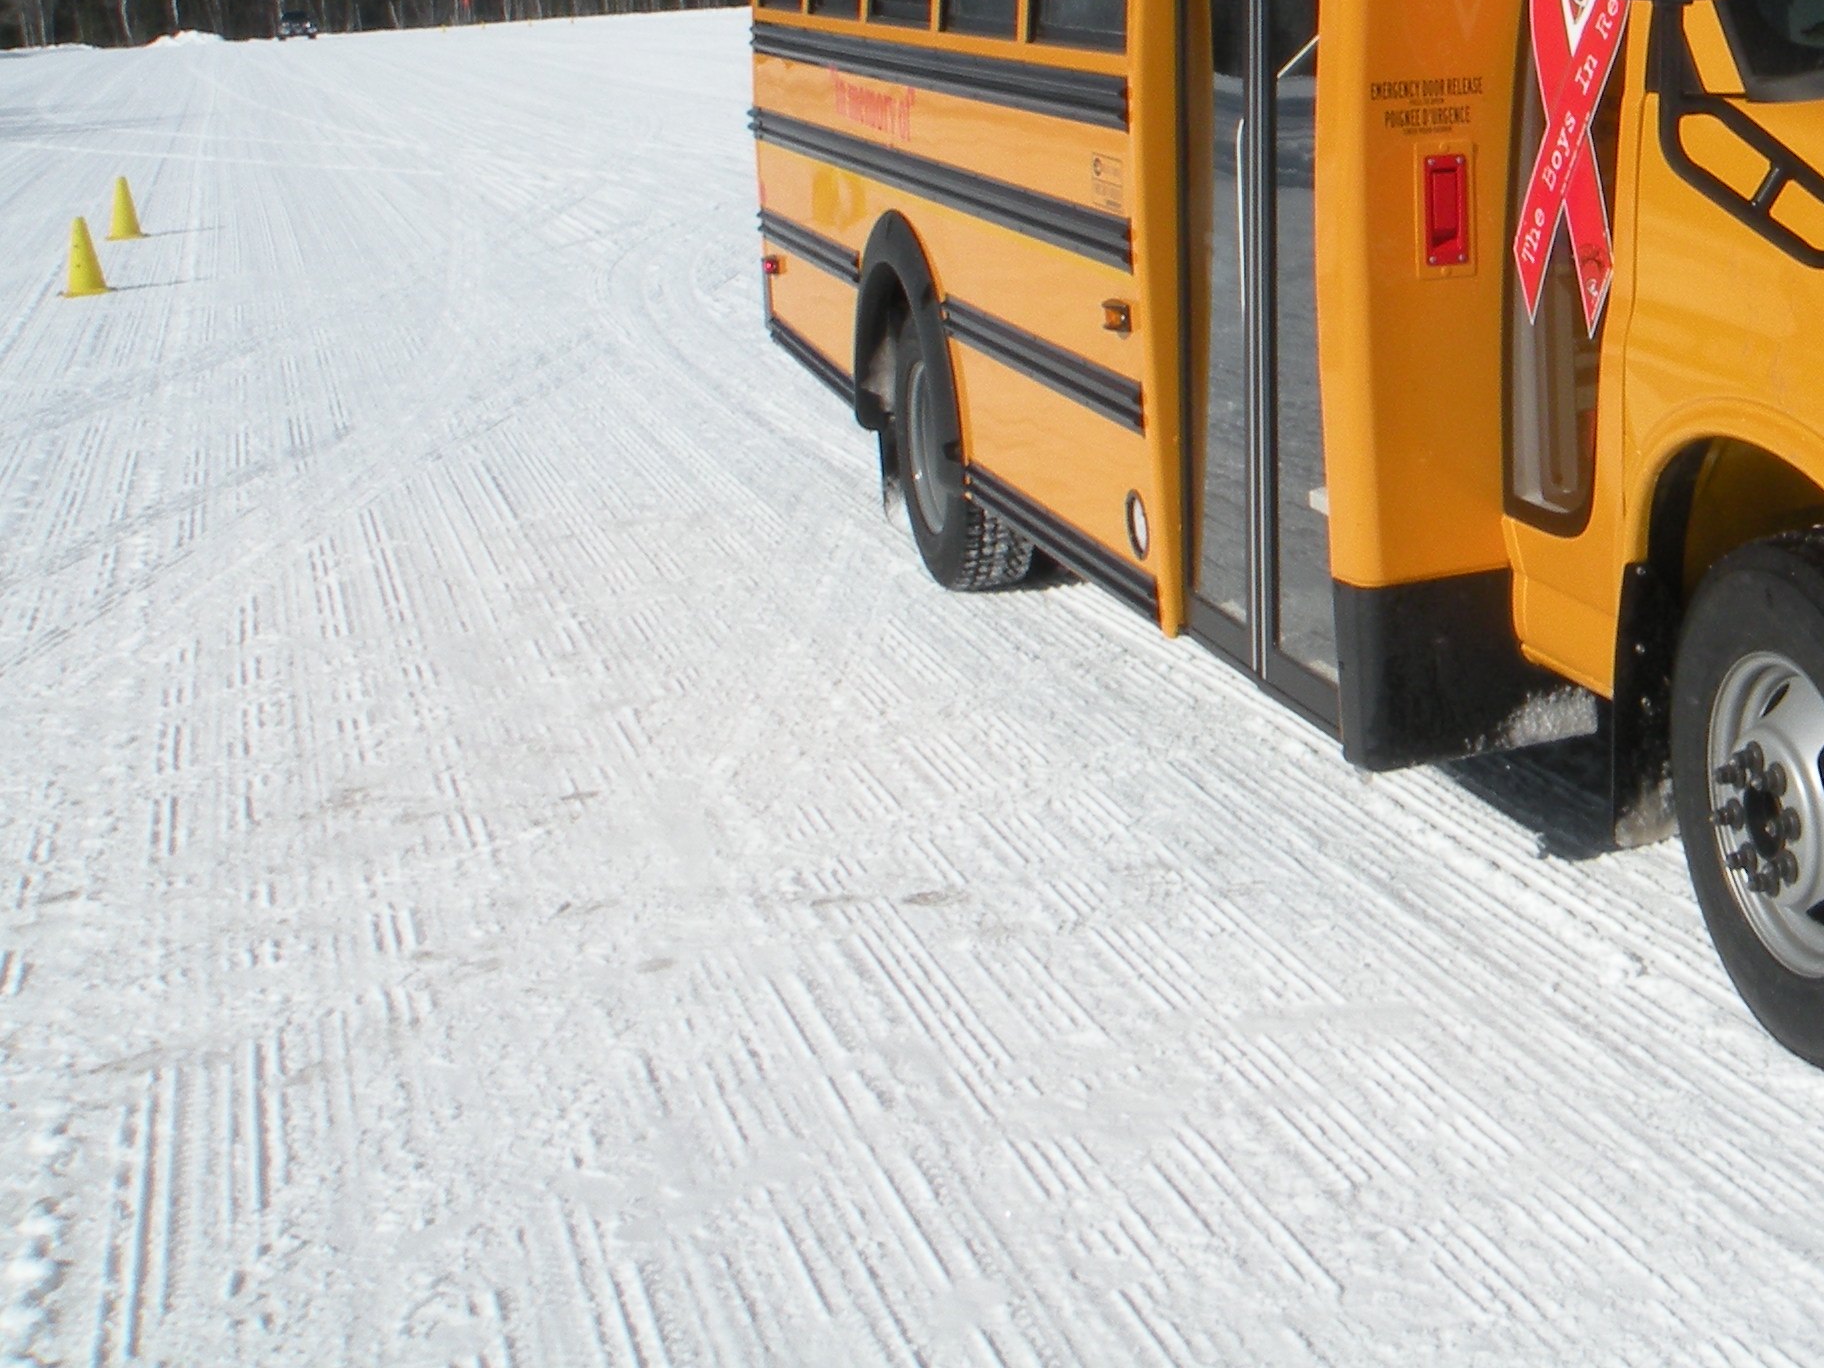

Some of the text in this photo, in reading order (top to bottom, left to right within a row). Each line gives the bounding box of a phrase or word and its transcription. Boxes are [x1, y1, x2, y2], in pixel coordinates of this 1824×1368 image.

[1370, 76, 1482, 101] EMERGENCY DOOR RELEASE
[1520, 207, 1546, 264] The
[1541, 110, 1577, 193] Boys
[1573, 53, 1599, 97] In
